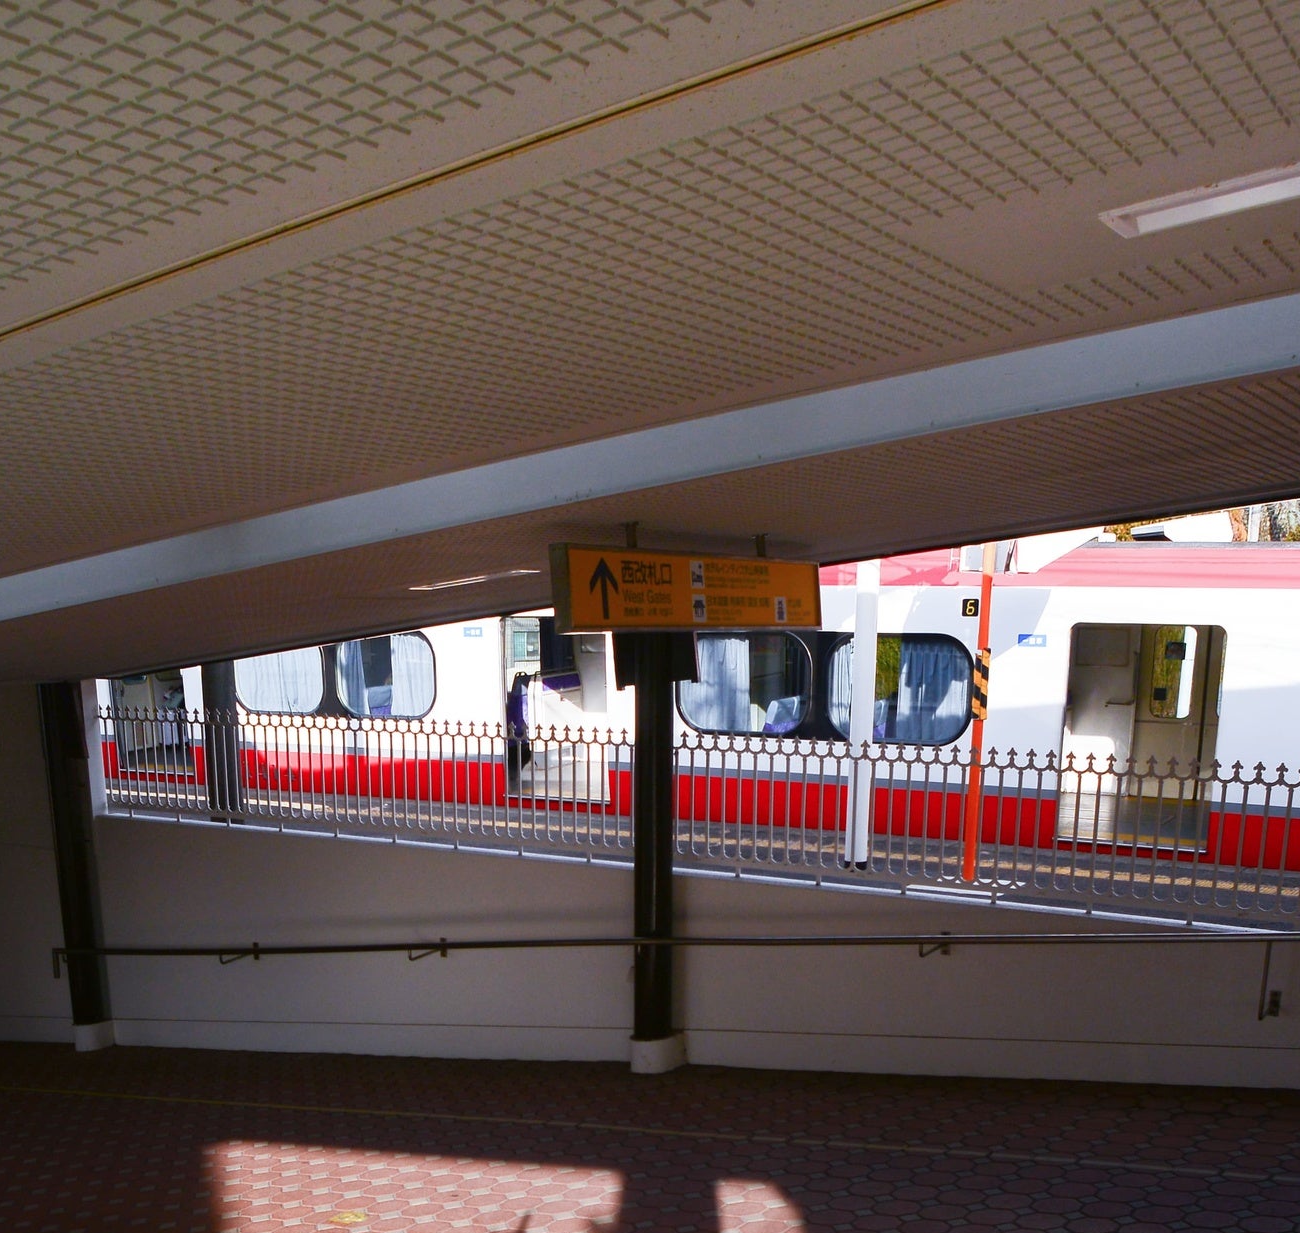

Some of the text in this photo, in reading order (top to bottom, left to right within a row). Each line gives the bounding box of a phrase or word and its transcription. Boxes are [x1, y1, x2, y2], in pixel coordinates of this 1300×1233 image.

[621, 561, 672, 585] 西改札口
[622, 589, 673, 605] West Gates
[966, 600, 975, 615] 6
